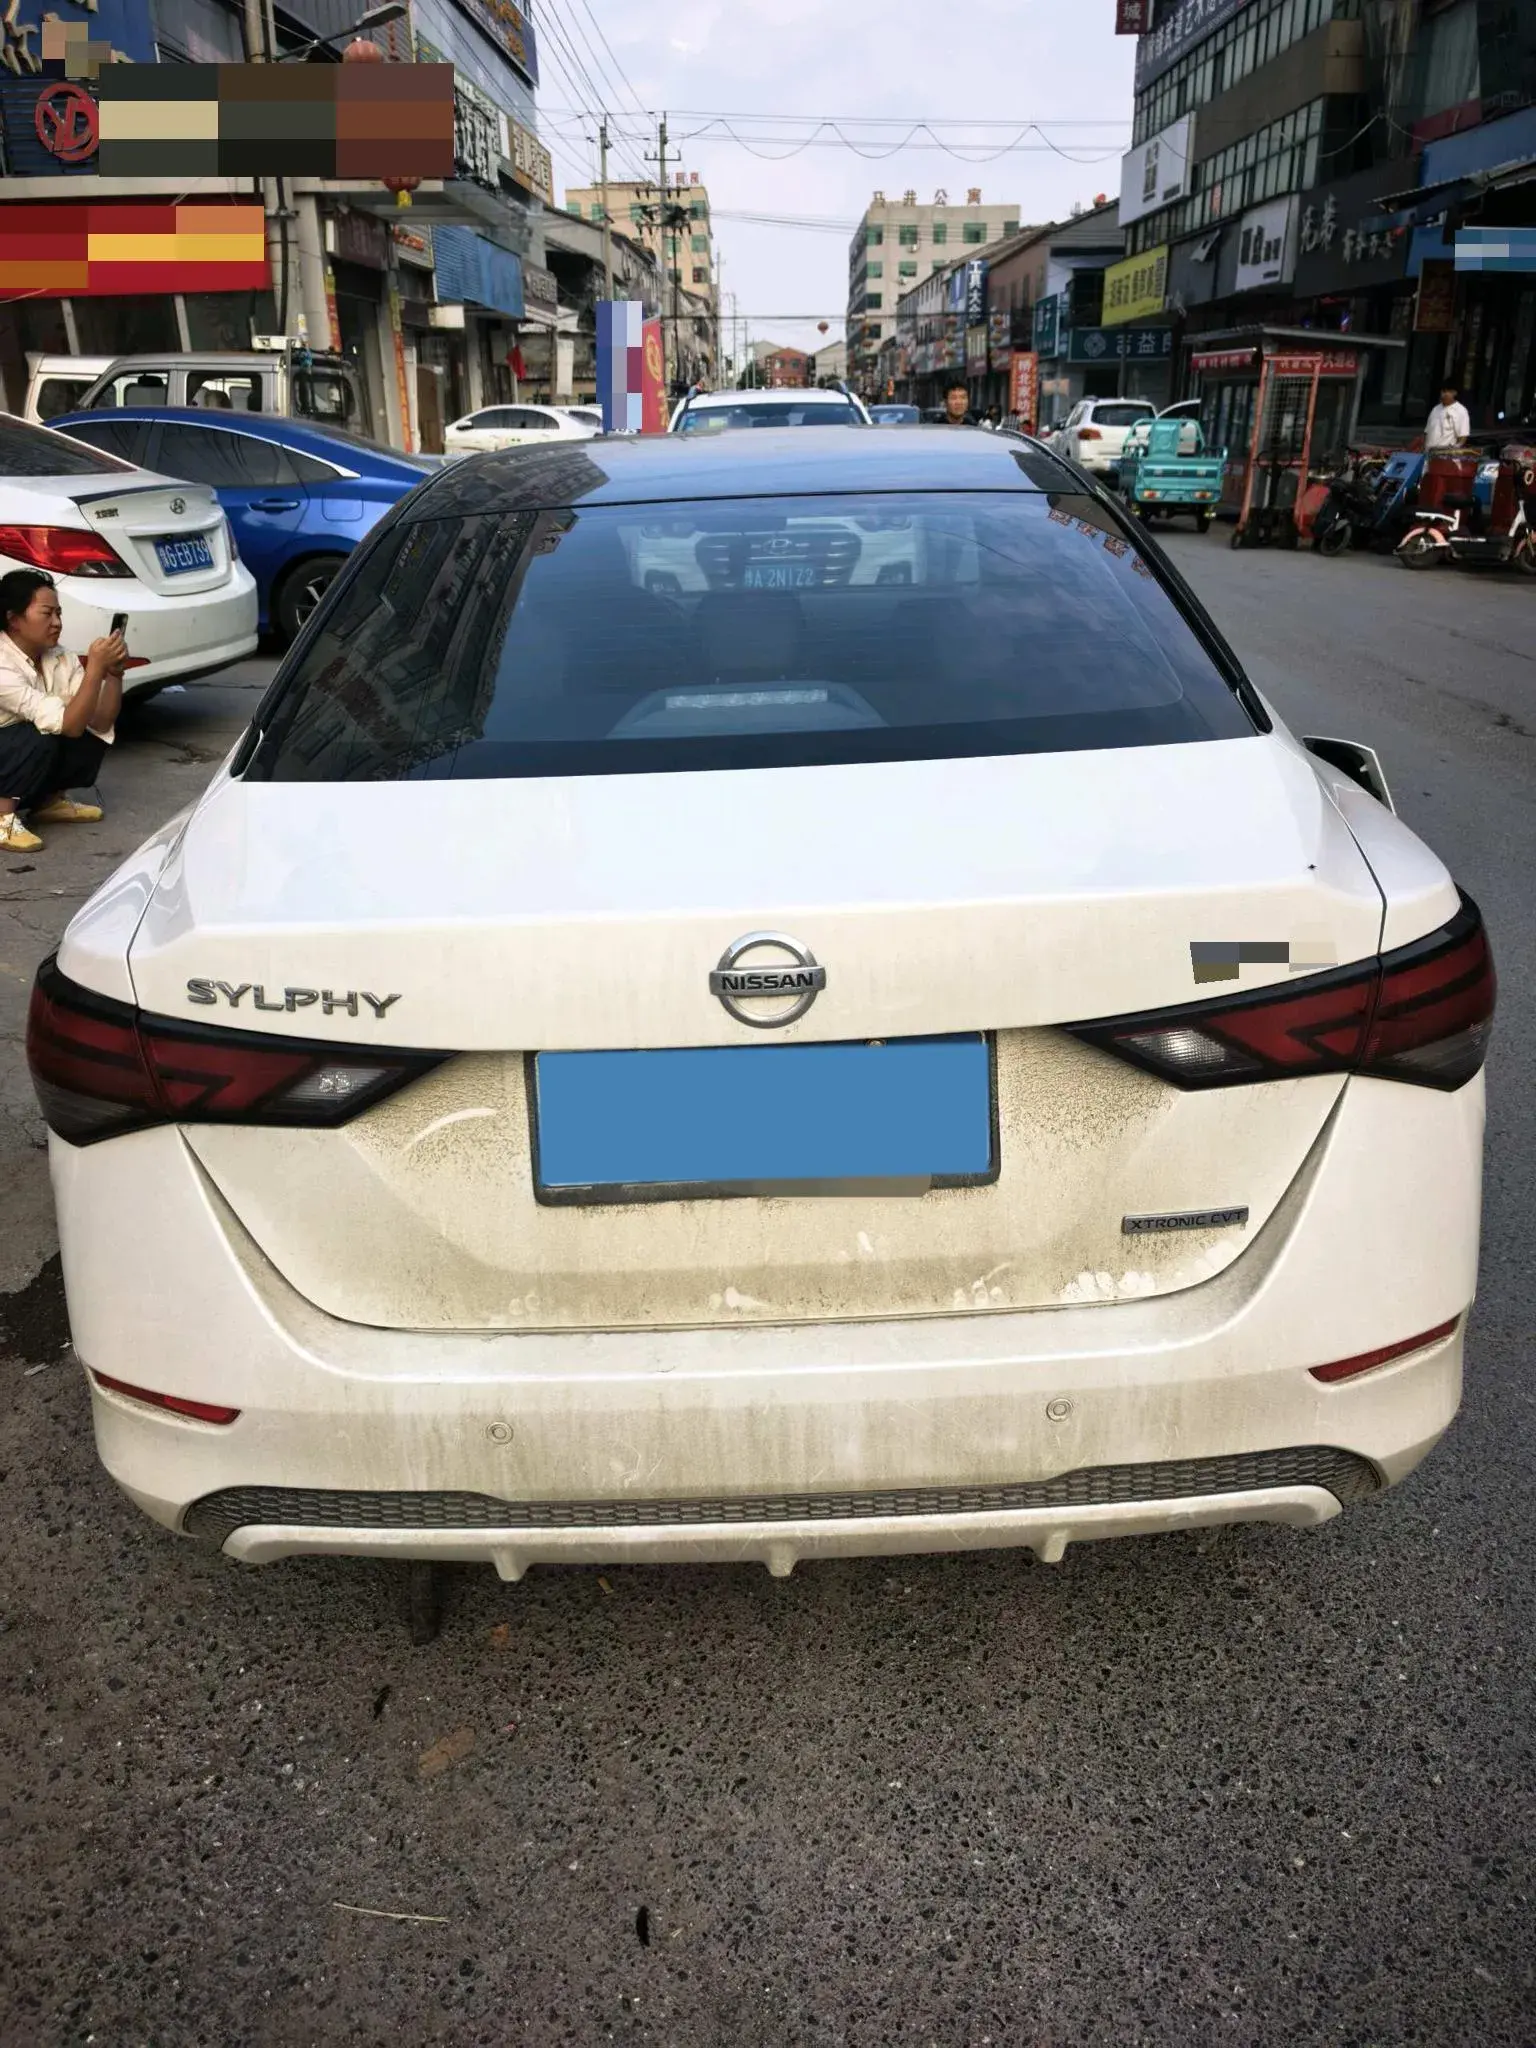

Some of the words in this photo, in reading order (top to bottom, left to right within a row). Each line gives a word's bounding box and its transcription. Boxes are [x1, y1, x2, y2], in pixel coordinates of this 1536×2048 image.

[721, 972, 815, 991] NISSAN
[186, 977, 402, 1019] SYLPHY
[1129, 1215, 1206, 1231] XTRONIC
[1210, 1210, 1246, 1225] CVT
